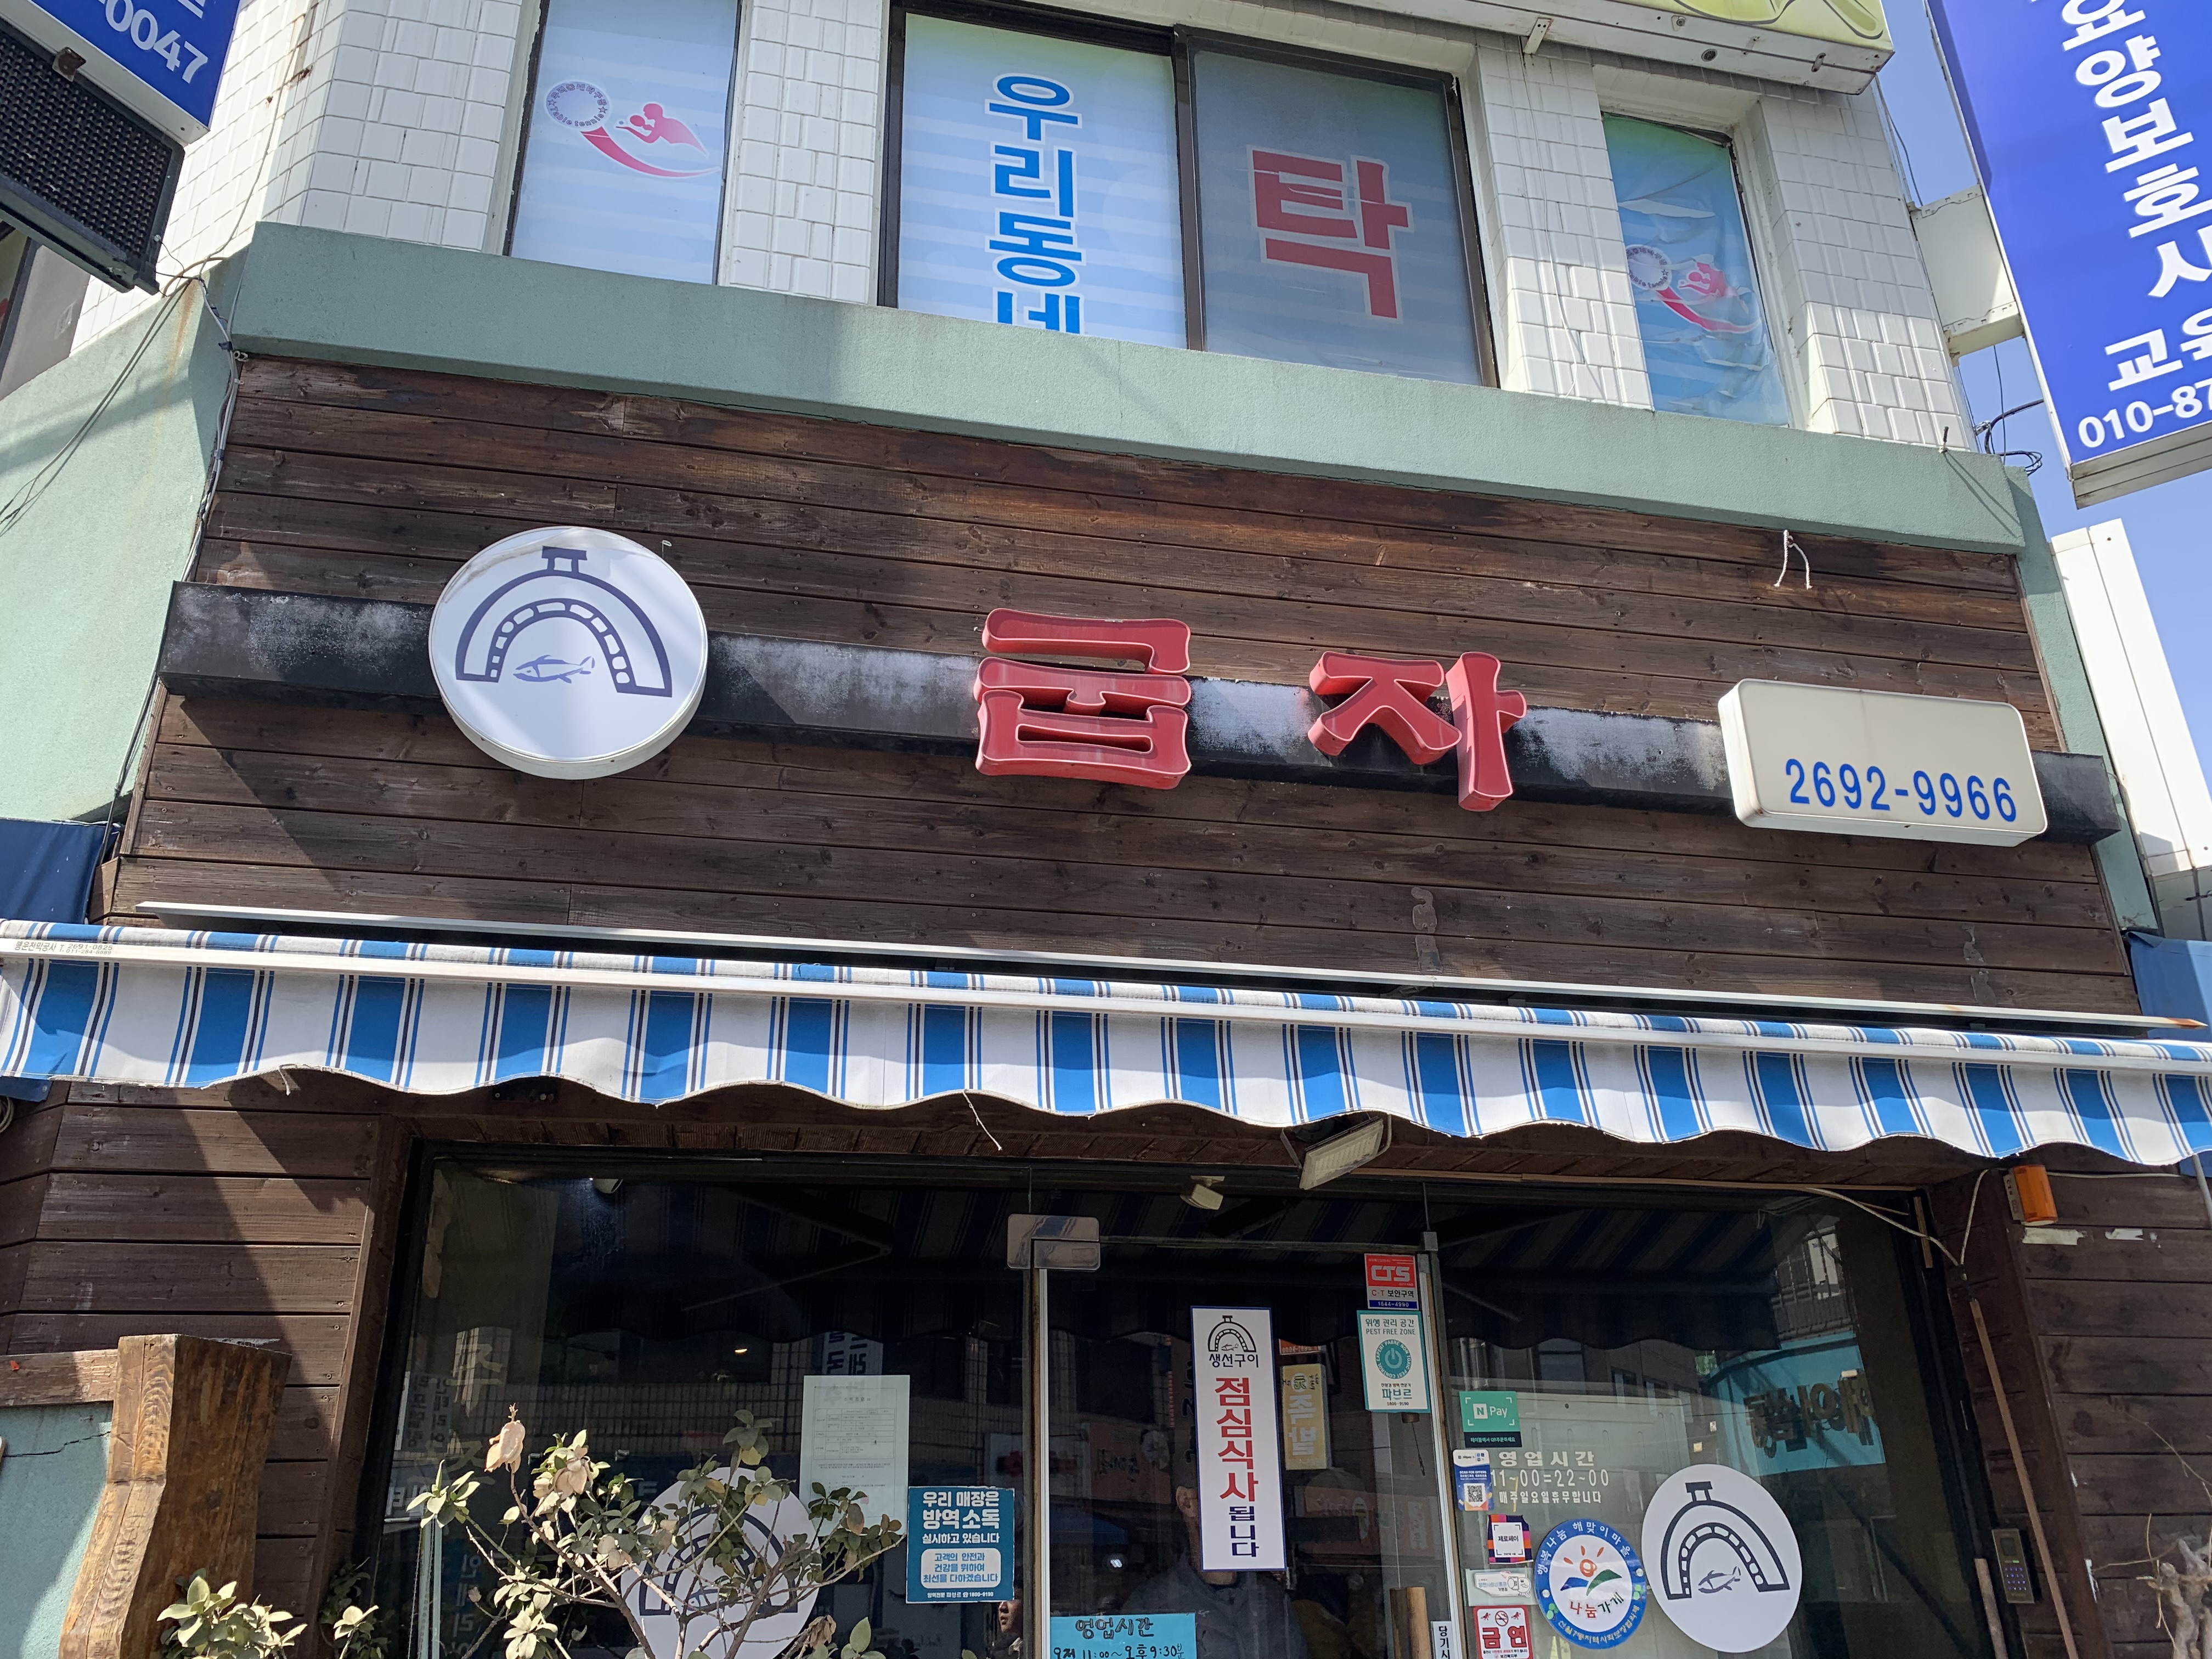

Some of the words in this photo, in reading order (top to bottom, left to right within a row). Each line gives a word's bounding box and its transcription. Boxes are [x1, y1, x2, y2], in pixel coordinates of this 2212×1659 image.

[98, 0, 208, 83] 0047
[550, 106, 572, 125] Table
[574, 113, 604, 127] tennis
[1252, 149, 1410, 319] 탁
[973, 608, 1527, 812] 굽자
[1785, 758, 2017, 822] 2692-9966
[1371, 1265, 1410, 1282] CTS
[1387, 1290, 1414, 1298] 보안구역
[1365, 1318, 1380, 1328] 위생
[1383, 1319, 1397, 1328] 관리
[1400, 1319, 1414, 1328] 공간
[1209, 1353, 1259, 1368] 생선구이
[1382, 1389, 1412, 1401] 파브르
[1489, 1406, 1508, 1418] Pay
[1215, 1378, 1259, 1502] 점심식사
[1499, 1451, 1595, 1467] 영업시간
[923, 1491, 952, 1507] 우리
[956, 1491, 999, 1507] 매장은
[923, 1509, 960, 1530] 방역
[962, 1509, 1000, 1529] 소독
[922, 1533, 960, 1544] 실시하고
[962, 1533, 1000, 1544] 있습니다
[1229, 1506, 1260, 1558] 됩니다
[934, 1553, 958, 1561] 고객의
[962, 1553, 985, 1561] 안전과
[1537, 1530, 1567, 1575] 행복나눔
[1572, 1521, 1631, 1558] 해맞이마을
[923, 1575, 947, 1583] 최선을
[950, 1573, 998, 1582] 다하겠습니다
[934, 1564, 958, 1572] 건강을
[961, 1564, 985, 1572] 위하여
[1570, 1591, 1624, 1619] 나눔가게
[1075, 1617, 1154, 1639] 영업시간
[1482, 1626, 1527, 1649] 금연
[1438, 1626, 1450, 1659] 당기시
